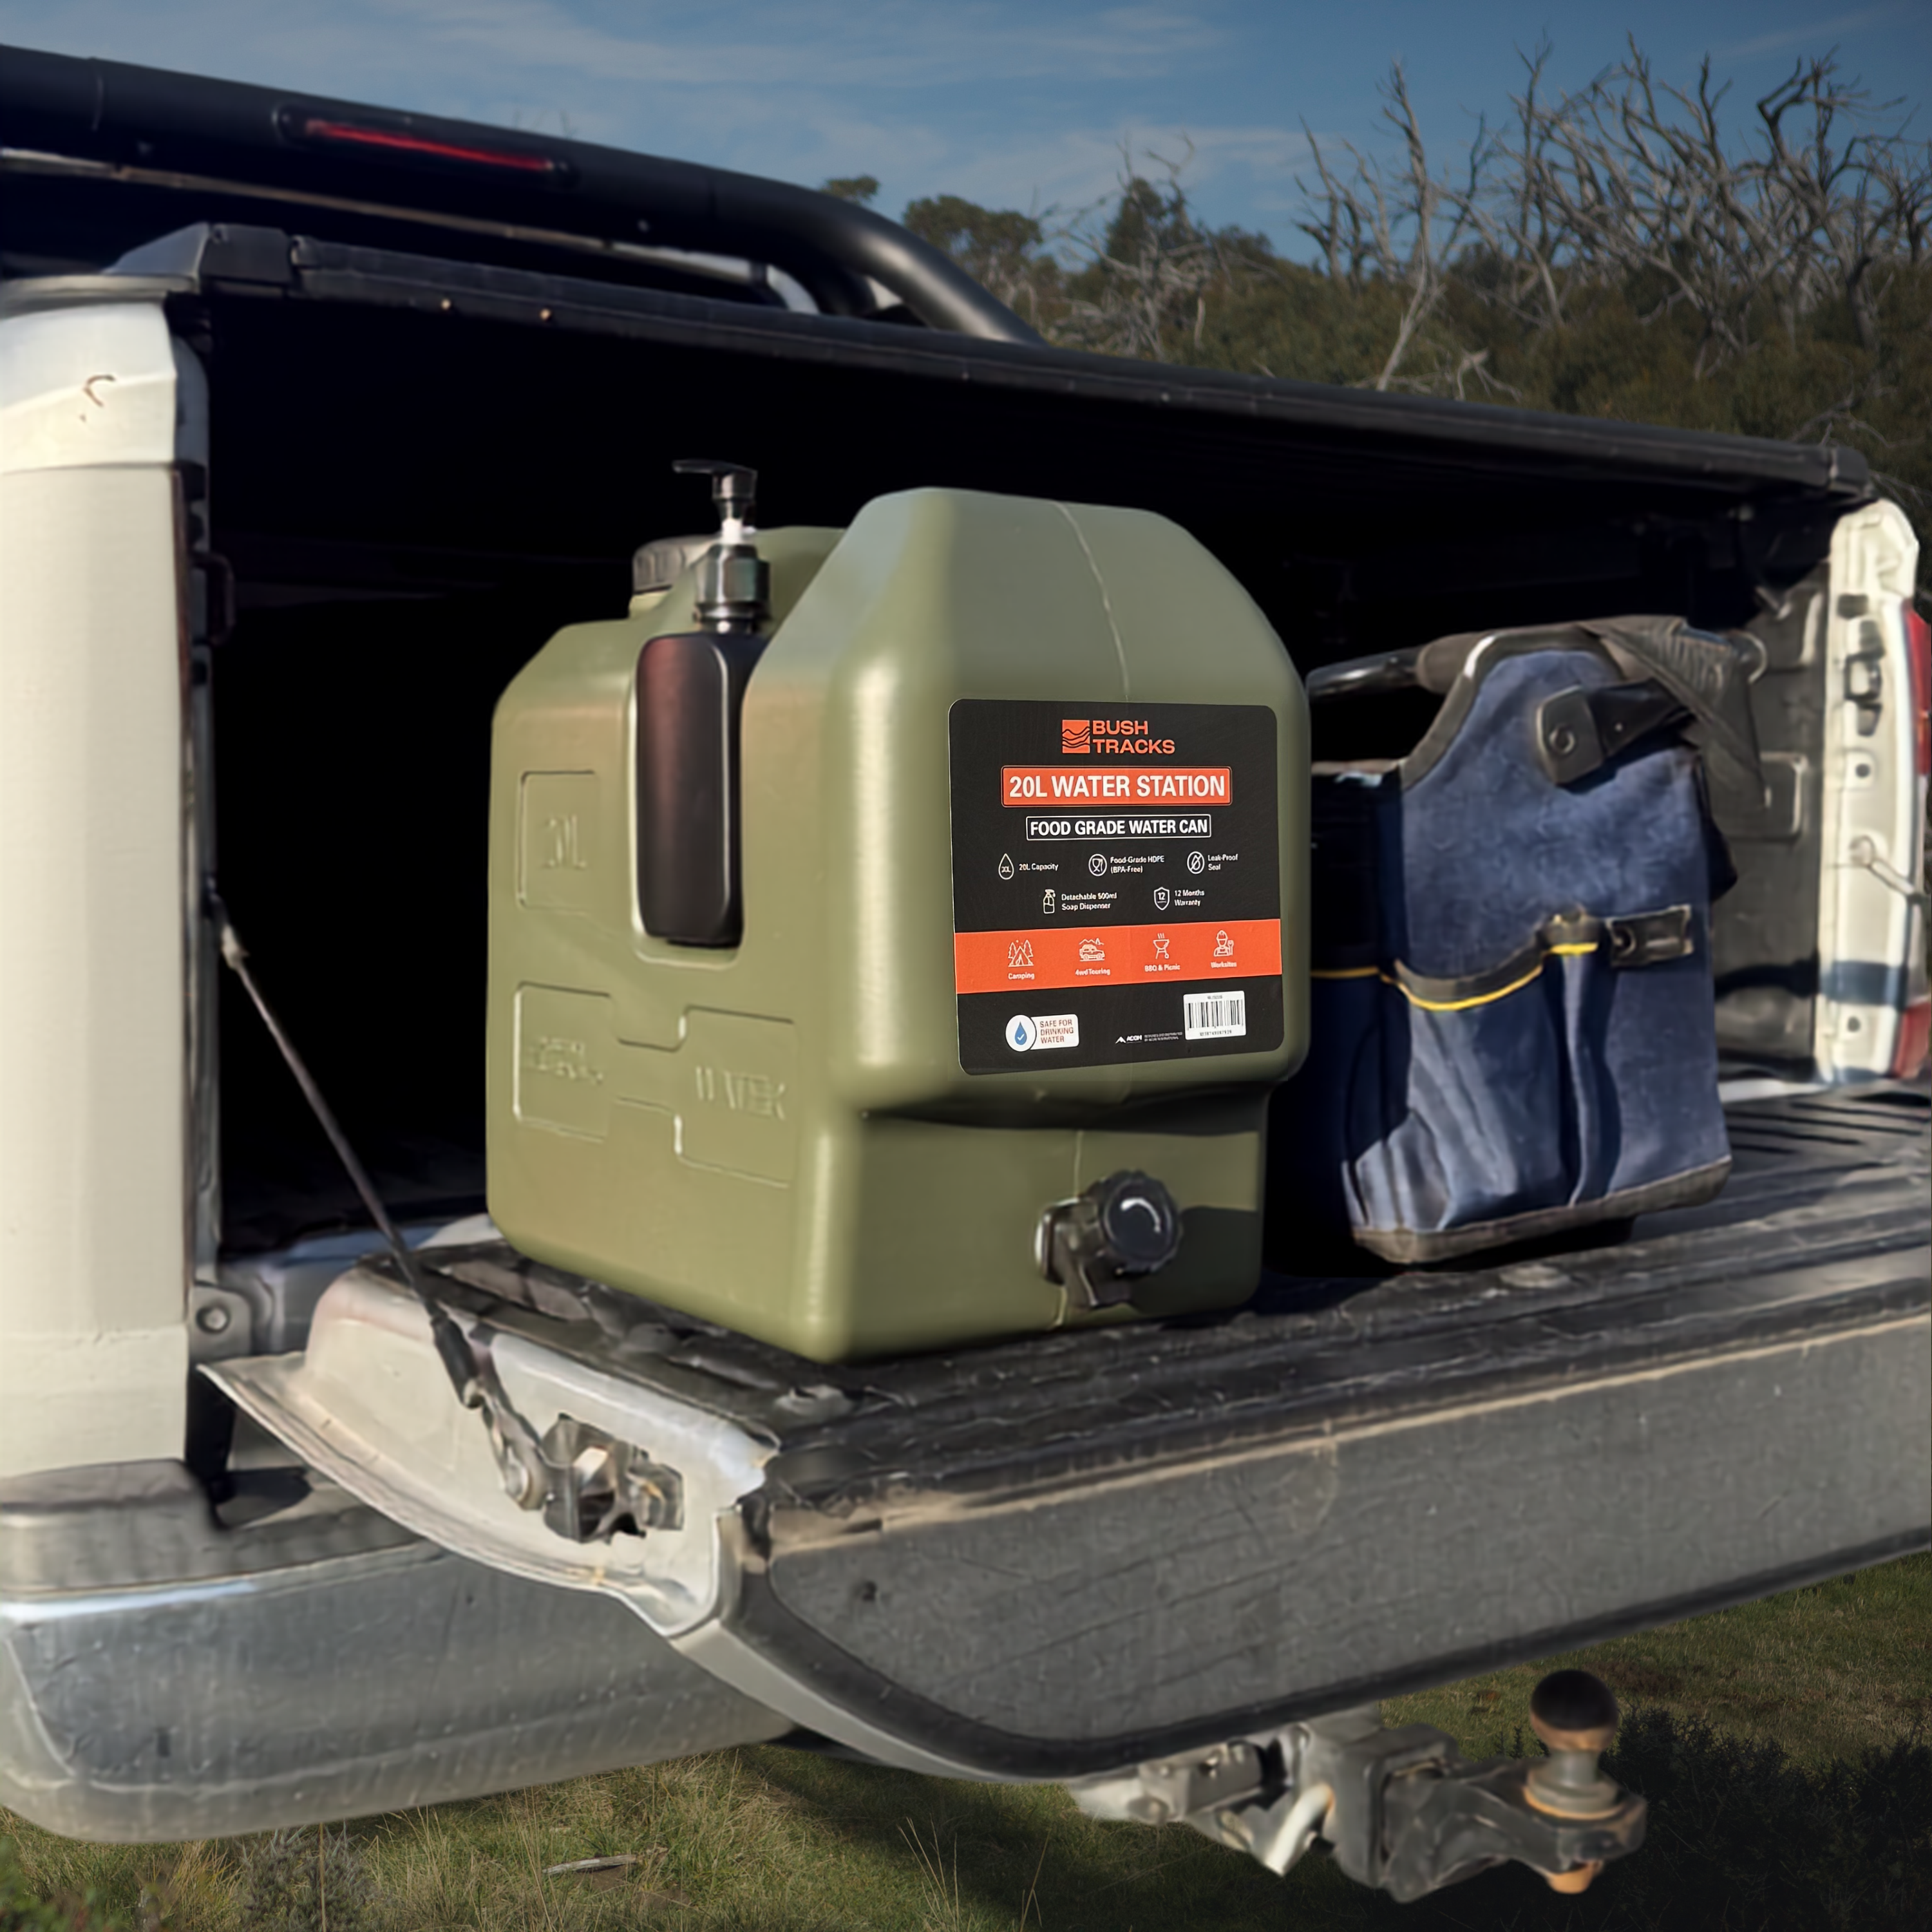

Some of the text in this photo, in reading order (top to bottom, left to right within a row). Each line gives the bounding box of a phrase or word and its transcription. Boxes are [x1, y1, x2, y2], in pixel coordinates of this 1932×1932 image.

[1093, 720, 1148, 735] BUSH
[1093, 739, 1175, 754] TRACKS
[1009, 775, 1225, 798] 20L WATER STATION
[1030, 819, 1208, 836] FOOD GRADE WATER CAN
[1110, 855, 1146, 864] Food-Grade
[1031, 862, 1059, 871] Capacity
[1110, 866, 1143, 874] (BPA-Free)
[1061, 893, 1096, 901] Detachable
[1157, 893, 1166, 901] 12
[1061, 902, 1111, 911] Soap Dispenser
[1008, 972, 1035, 980] Camping
[1039, 1019, 1057, 1028] SAFE
[1040, 1027, 1074, 1036] DRINKING
[1041, 1036, 1065, 1044] WATER
